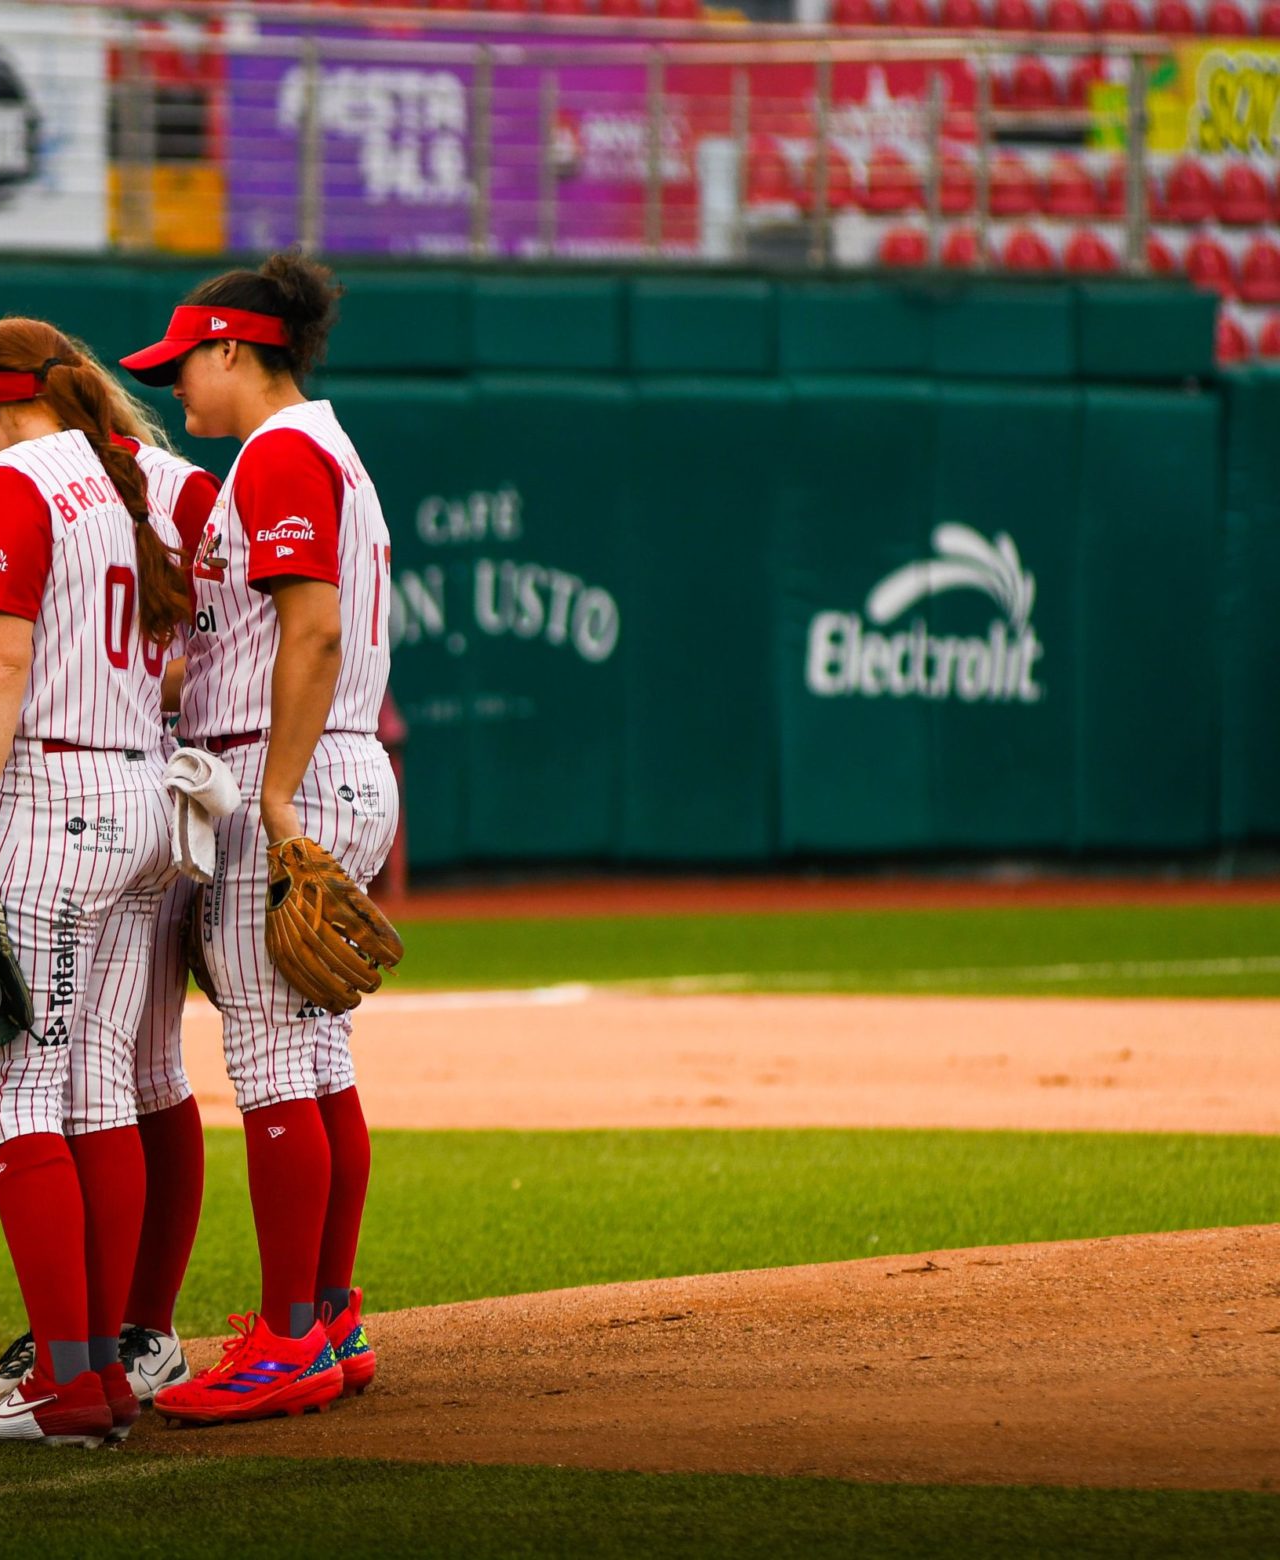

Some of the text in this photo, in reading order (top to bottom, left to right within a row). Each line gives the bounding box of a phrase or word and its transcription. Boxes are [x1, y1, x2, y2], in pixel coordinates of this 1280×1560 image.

[256, 527, 316, 543] Electrolit
[806, 609, 1043, 703] Electrolit
[99, 816, 117, 825] Best
[90, 823, 124, 832] Western
[97, 832, 119, 841] PLUS
